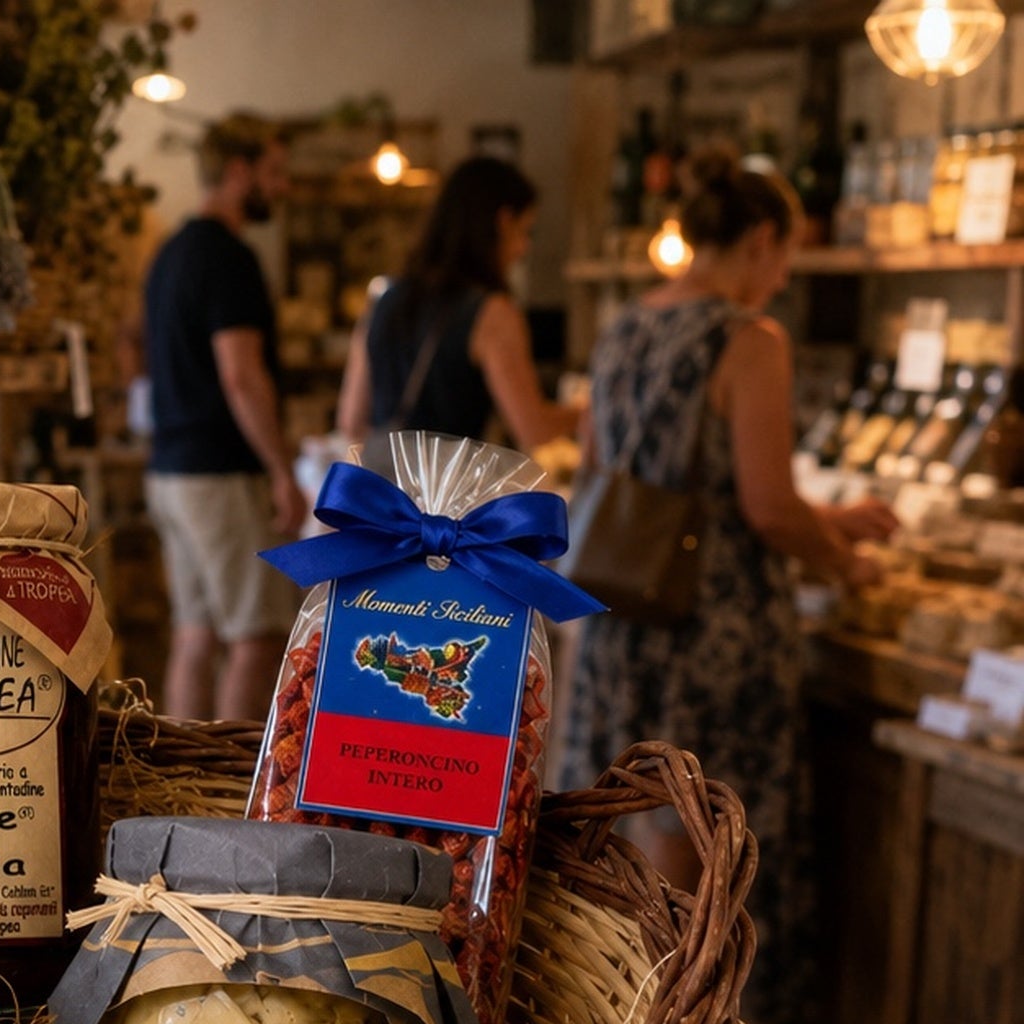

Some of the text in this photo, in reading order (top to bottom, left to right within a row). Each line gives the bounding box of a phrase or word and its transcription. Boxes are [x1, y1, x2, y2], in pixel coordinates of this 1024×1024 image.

[342, 588, 514, 629] Momenti Siciliani
[19, 766, 27, 779] a
[339, 742, 480, 775] PEPERONCINO
[367, 769, 444, 793] INTERO
